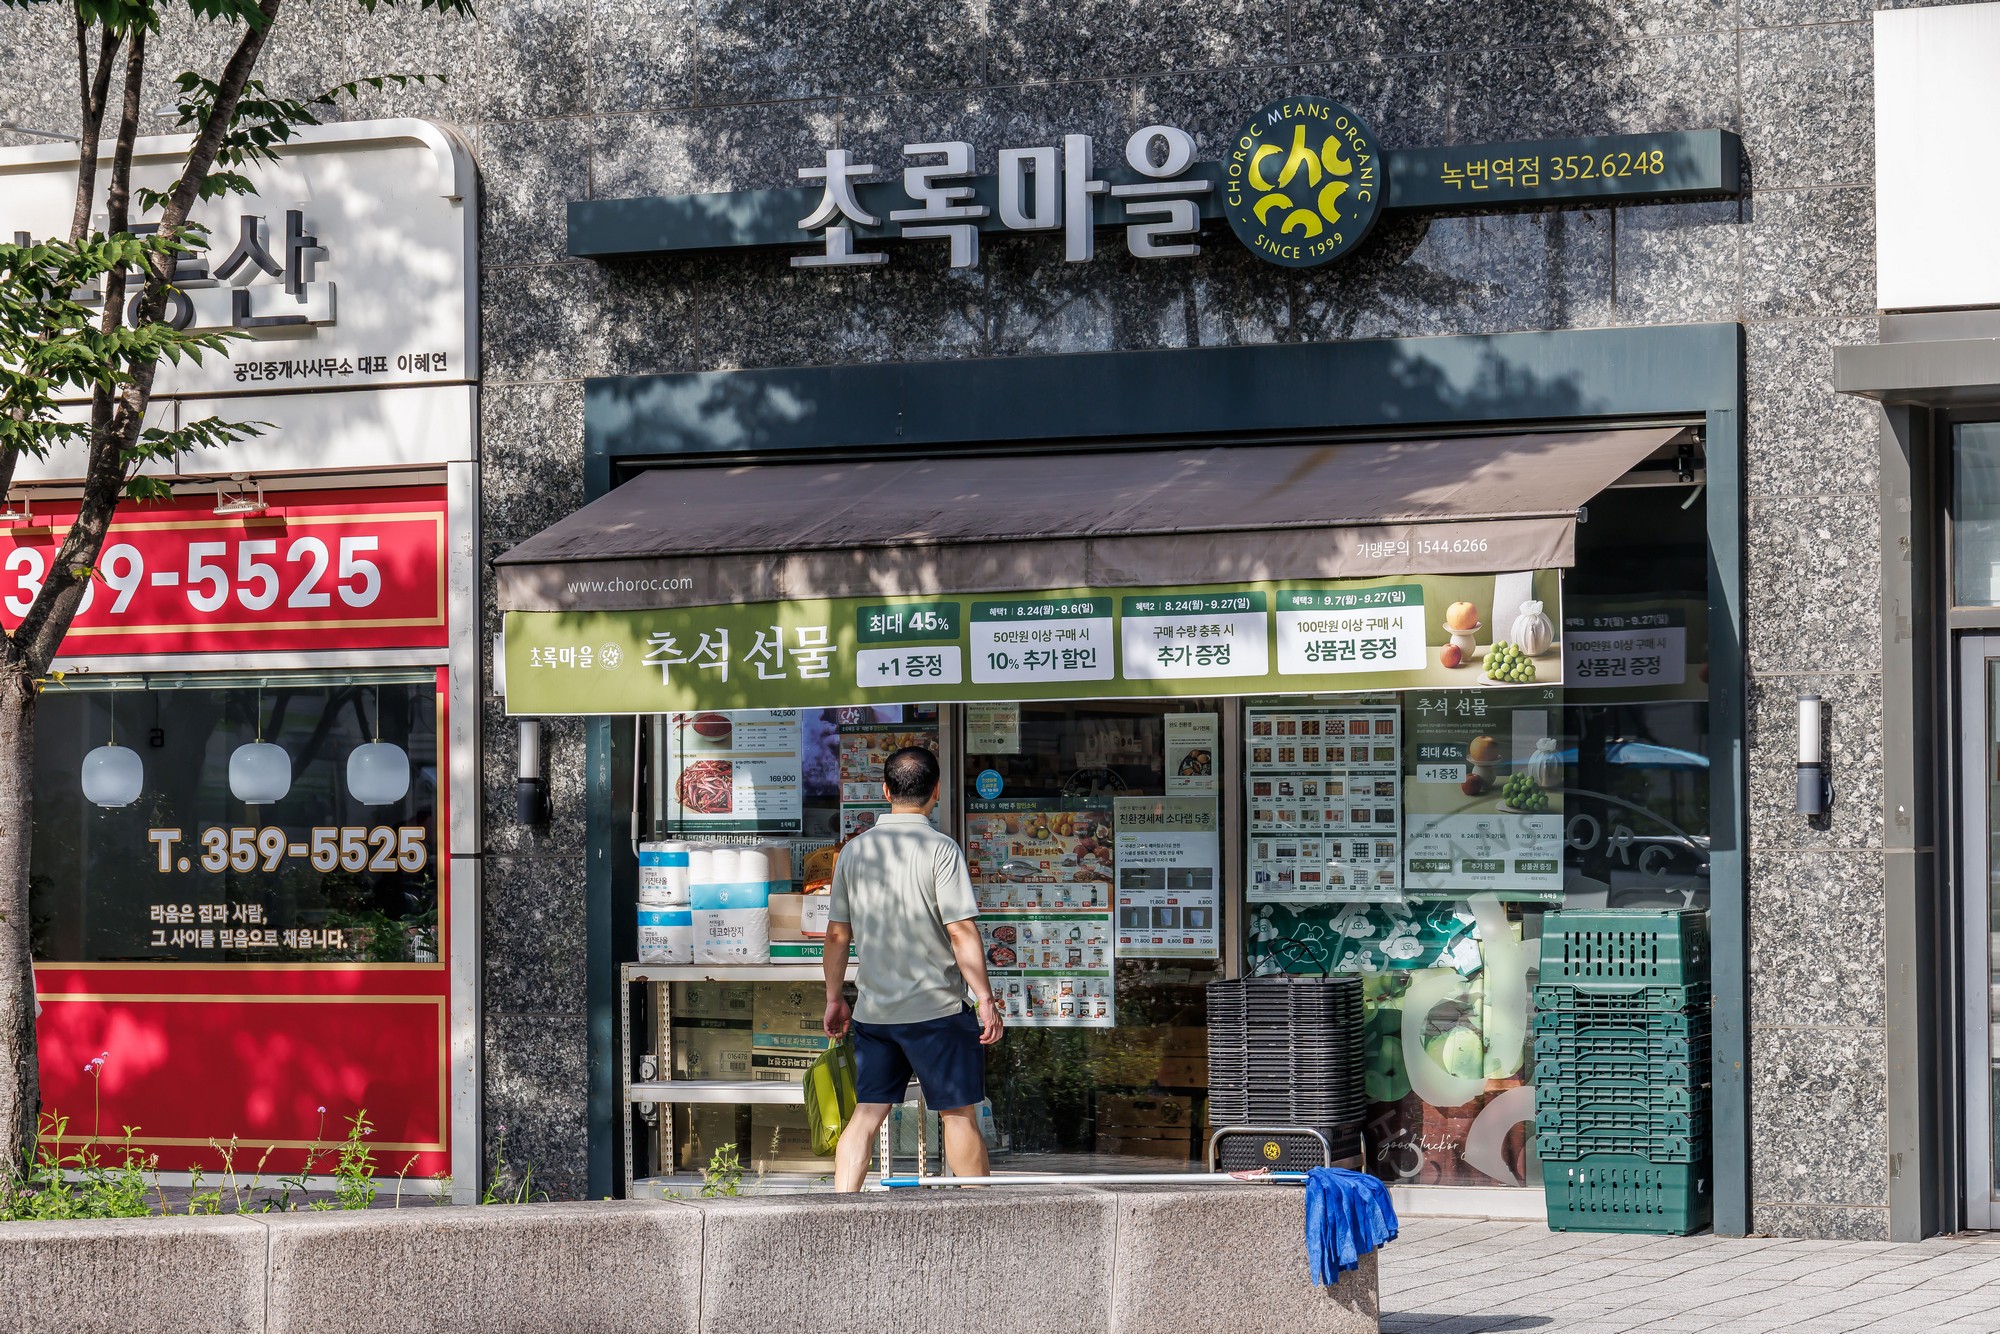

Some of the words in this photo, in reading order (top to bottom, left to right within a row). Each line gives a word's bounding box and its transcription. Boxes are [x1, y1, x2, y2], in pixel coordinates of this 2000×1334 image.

[1228, 123, 1263, 207] CHOROC
[1267, 103, 1330, 126] MEANS
[1335, 116, 1373, 203] ORGANIC
[1440, 156, 1541, 191] 녹번역점
[1549, 150, 1665, 182] 352.6248
[790, 125, 1215, 268] 초록마을
[1254, 234, 1300, 259] SINCE
[1309, 232, 1343, 257] 1999
[233, 361, 354, 382] 공인중개사사무소
[358, 359, 389, 375] 대표
[397, 351, 448, 373] 이혜연
[1356, 541, 1410, 558] 가맹문의
[1416, 538, 1488, 554] 1544.6266
[567, 575, 694, 593] www.choroc.com
[1136, 601, 1155, 612] 혜택2
[1292, 595, 1313, 606] 혜택3
[989, 606, 1008, 616] 혜택1
[869, 613, 903, 634] 최대
[908, 612, 949, 632] 45%
[1153, 626, 1174, 639] 구매
[1176, 625, 1197, 638] 수량
[1198, 624, 1221, 637] 충족
[1223, 623, 1235, 636] 시
[1297, 620, 1339, 634] 100만원
[1341, 619, 1364, 632] 이상
[1366, 617, 1389, 631] 구매
[1391, 616, 1403, 630] 시
[993, 631, 1029, 644] 50만원
[1031, 630, 1053, 643] 이상
[1055, 629, 1077, 642] 구매
[1079, 628, 1090, 641] 시
[530, 645, 594, 669] 초록마을
[641, 628, 729, 686] 추석
[743, 625, 837, 680] 선물
[1157, 646, 1192, 667] 추가
[1195, 644, 1231, 666] 증정
[1304, 640, 1356, 662] 상품권
[1359, 637, 1398, 660] 증정
[877, 657, 900, 676] +1
[905, 654, 943, 678] 증정
[987, 652, 1020, 670] 10%
[1023, 650, 1059, 671] 추가
[1061, 648, 1097, 669] 할인
[1576, 657, 1627, 677] 상품권
[1630, 655, 1661, 676] 증정
[1543, 689, 1554, 699] 26
[769, 709, 796, 718] 142,500
[1416, 698, 1449, 716] 추석
[1455, 698, 1488, 716] 선물
[1420, 746, 1440, 759] 최대
[1442, 747, 1463, 758] 45%
[769, 775, 796, 783] 169,900
[1425, 769, 1437, 779] +1
[1439, 768, 1458, 780] 증정
[1119, 813, 1164, 824] 친환경세제
[1166, 813, 1193, 824] 소다랩
[1195, 813, 1210, 824] 5종
[148, 827, 190, 874] T.
[200, 826, 427, 874] 359-5525
[1471, 862, 1482, 871] 추가
[1483, 862, 1496, 871] 증정
[1520, 863, 1539, 871] 상품권
[1540, 863, 1552, 871] 증정
[645, 877, 668, 885] 키친타올
[150, 904, 195, 923] 라움은
[199, 904, 229, 923] 집과
[232, 904, 268, 926] 사람,
[151, 930, 167, 947] 그
[170, 929, 215, 949] 사이를
[220, 929, 278, 948] 믿음으로
[282, 929, 348, 949] 채웁니다.
[645, 936, 668, 944] 키친타올
[709, 926, 744, 937] 데코화장지
